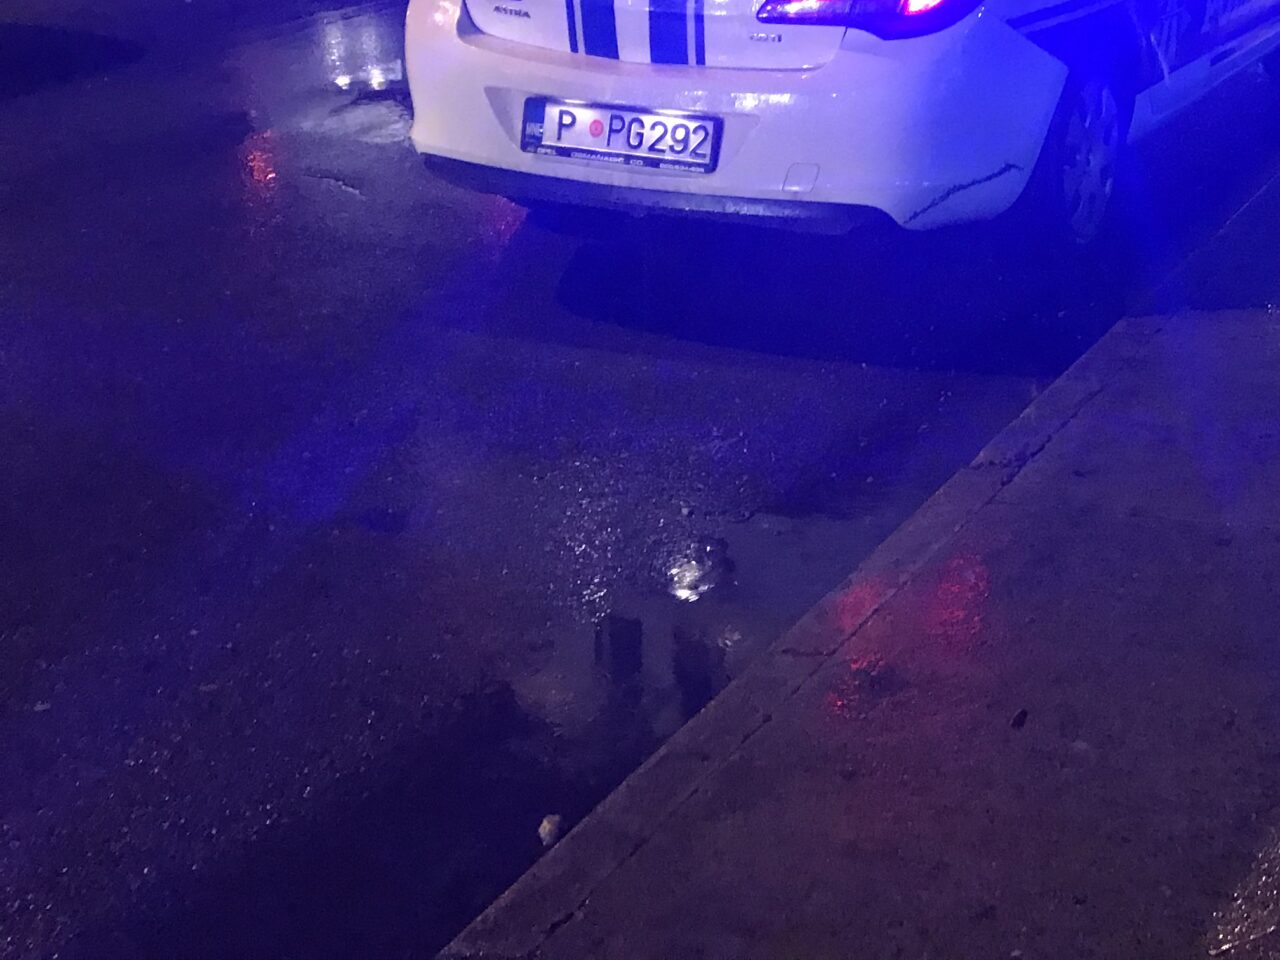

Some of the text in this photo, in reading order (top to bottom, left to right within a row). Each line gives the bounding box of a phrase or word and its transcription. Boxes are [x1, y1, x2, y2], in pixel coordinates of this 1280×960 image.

[493, 5, 531, 19] ASTRA
[556, 109, 710, 159] P PG292
